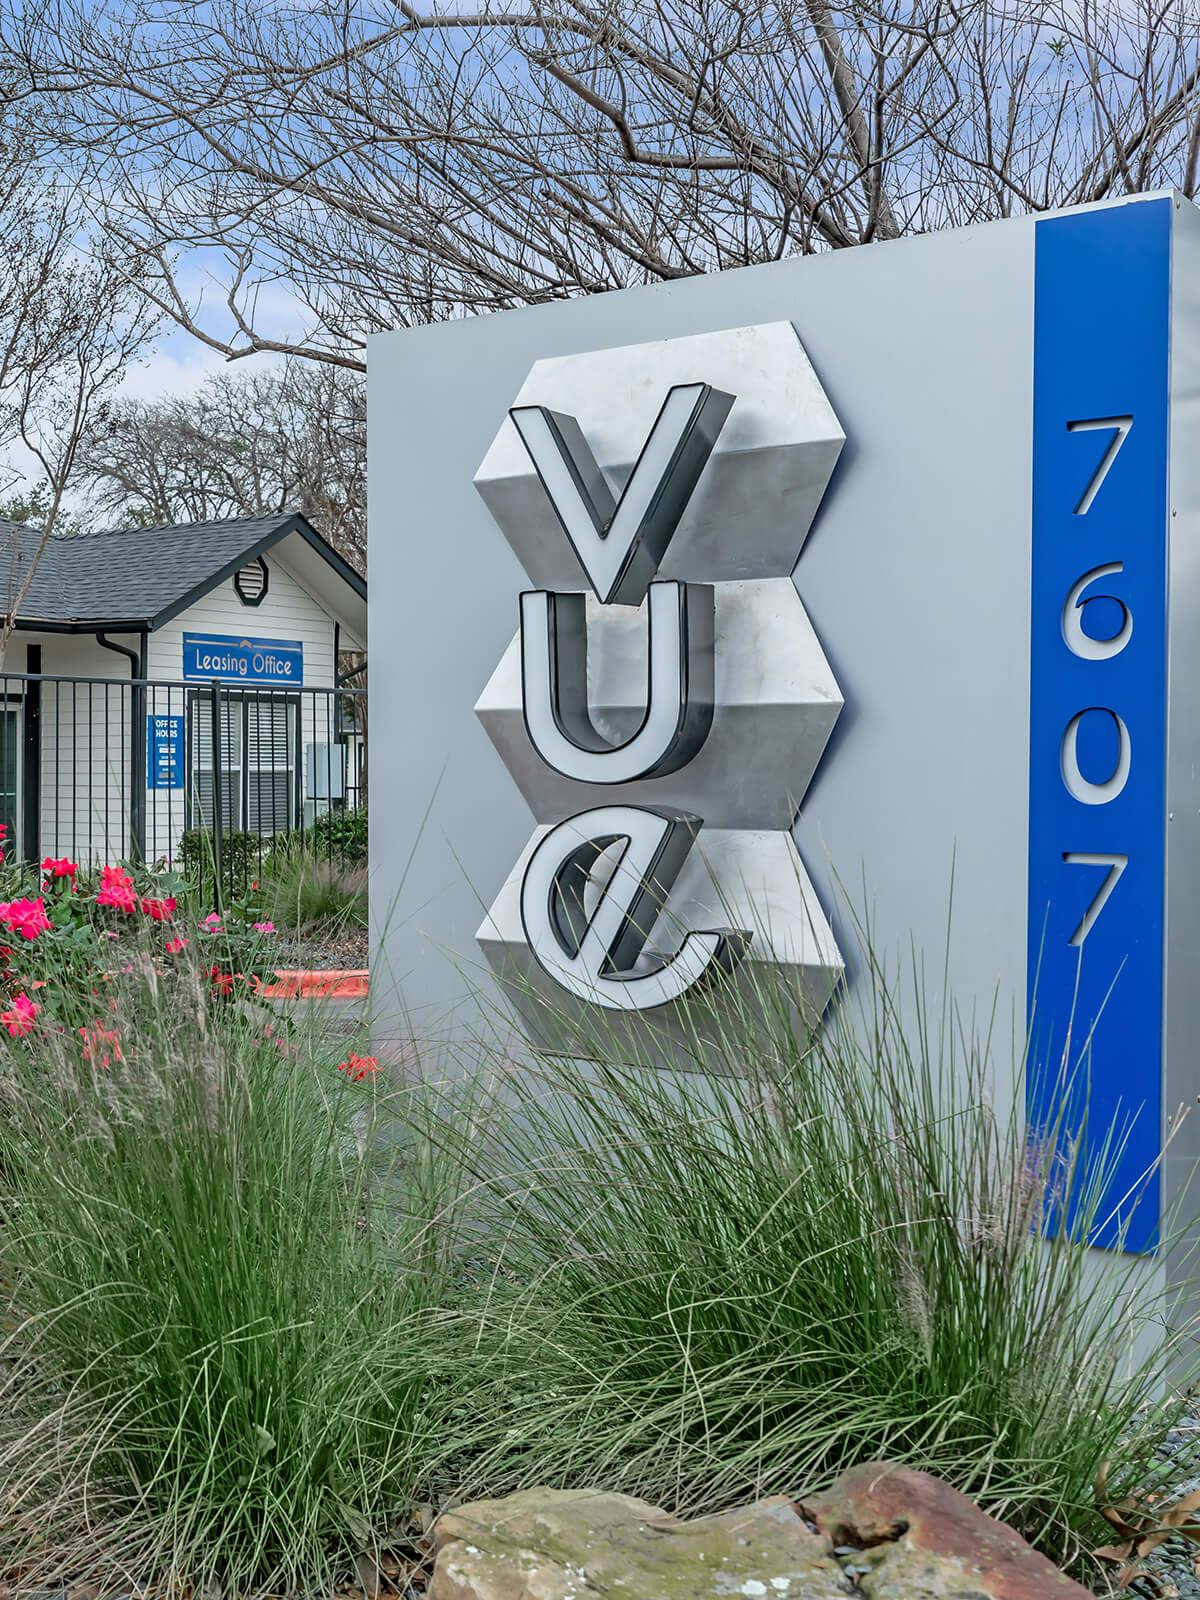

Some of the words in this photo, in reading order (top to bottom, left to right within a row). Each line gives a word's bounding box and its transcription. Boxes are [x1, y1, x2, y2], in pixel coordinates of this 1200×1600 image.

[196, 648, 248, 676] Leasing
[253, 653, 292, 675] Office
[1060, 414, 1134, 947] 7607
[155, 719, 178, 728] OFFCE
